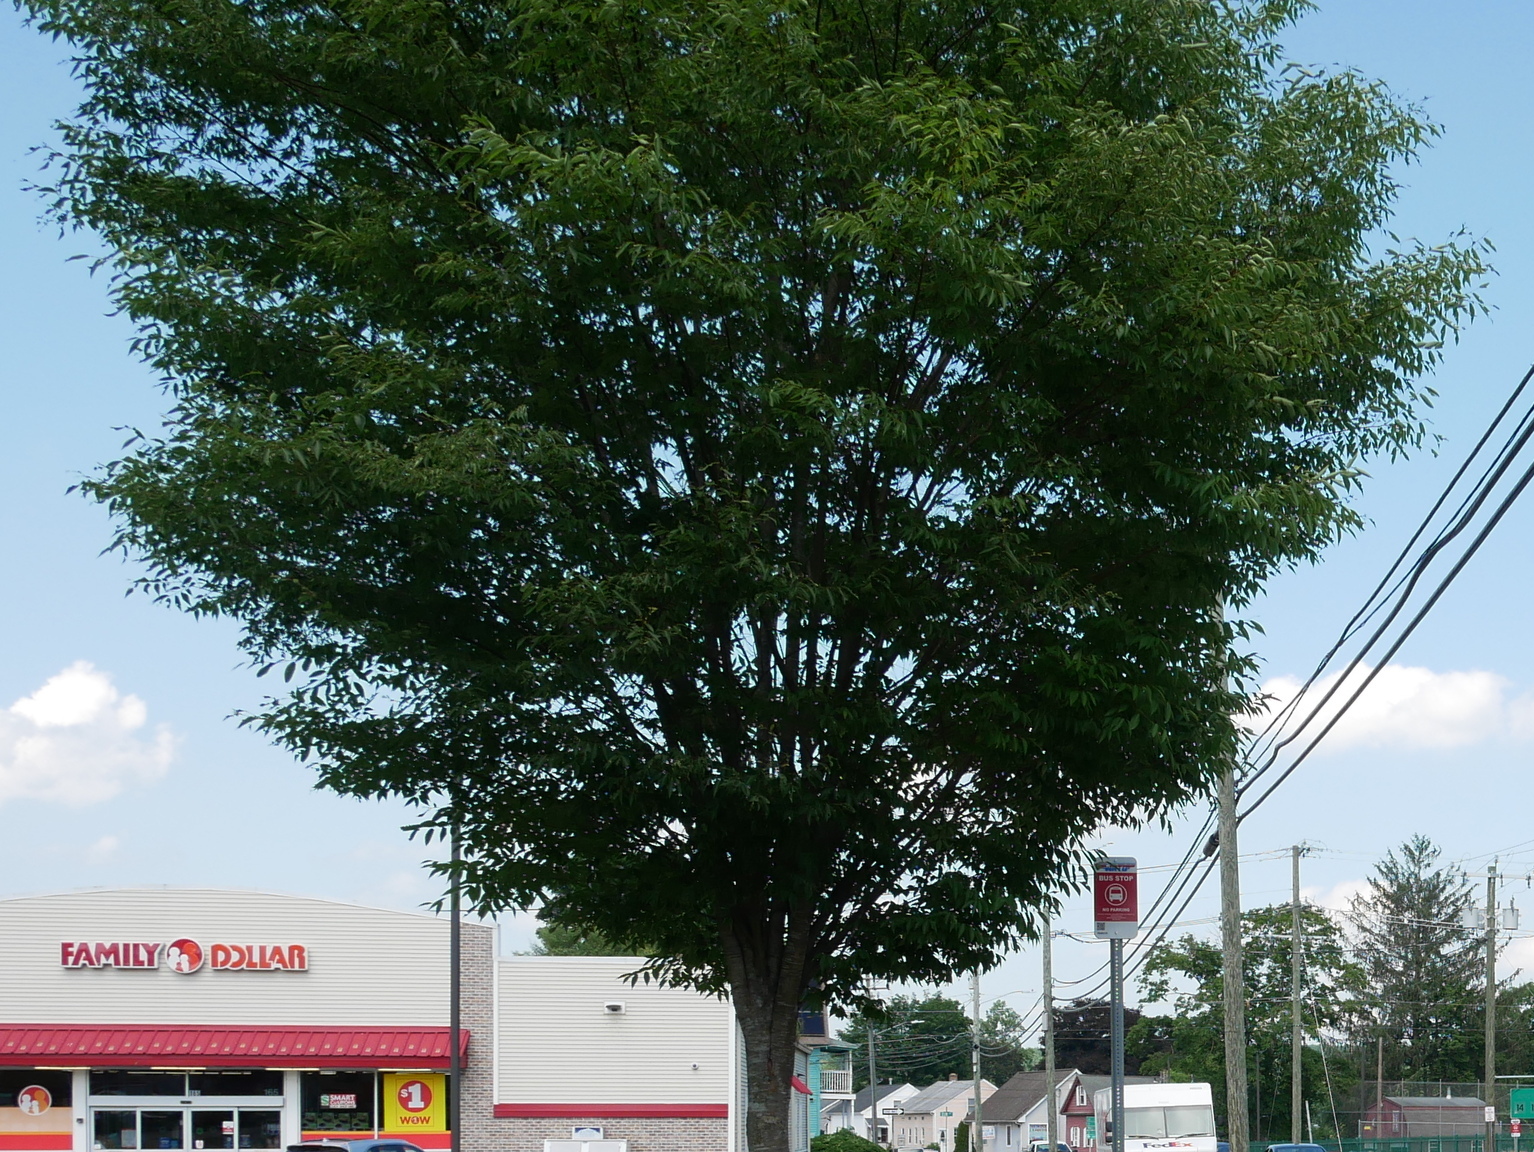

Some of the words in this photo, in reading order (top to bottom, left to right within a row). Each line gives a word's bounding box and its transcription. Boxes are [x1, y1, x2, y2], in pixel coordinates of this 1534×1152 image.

[61, 942, 161, 967] FAMILY
[211, 943, 308, 970] DOLLAR
[1516, 1103, 1524, 1111] 14
